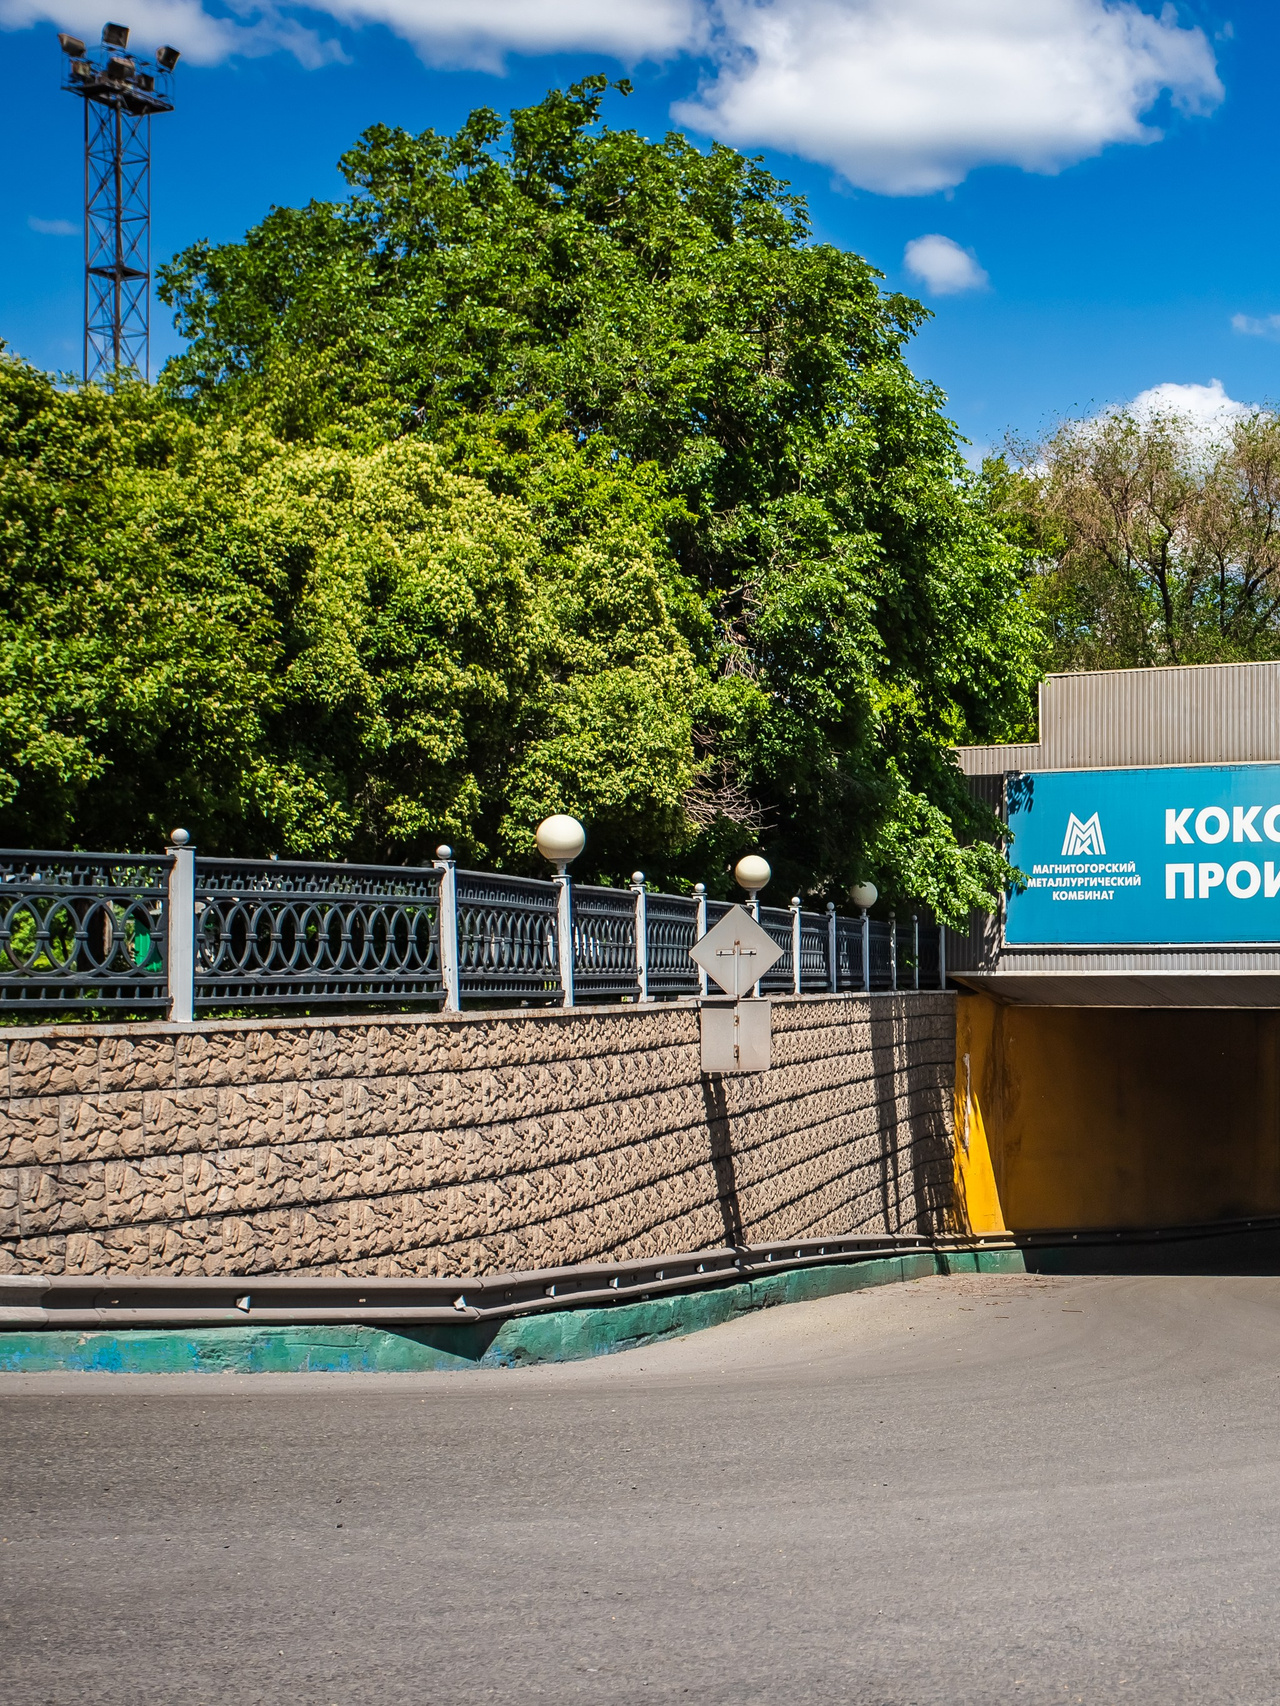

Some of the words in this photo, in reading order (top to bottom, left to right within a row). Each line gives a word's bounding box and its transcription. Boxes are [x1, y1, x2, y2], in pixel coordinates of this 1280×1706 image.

[1032, 861, 1136, 875] МАГНИТОГОРСКИЙ
[1027, 874, 1141, 888] МЕТАЛЛУРГИЧЕСКИЙ
[1053, 891, 1114, 900] КОМБИНАТ
